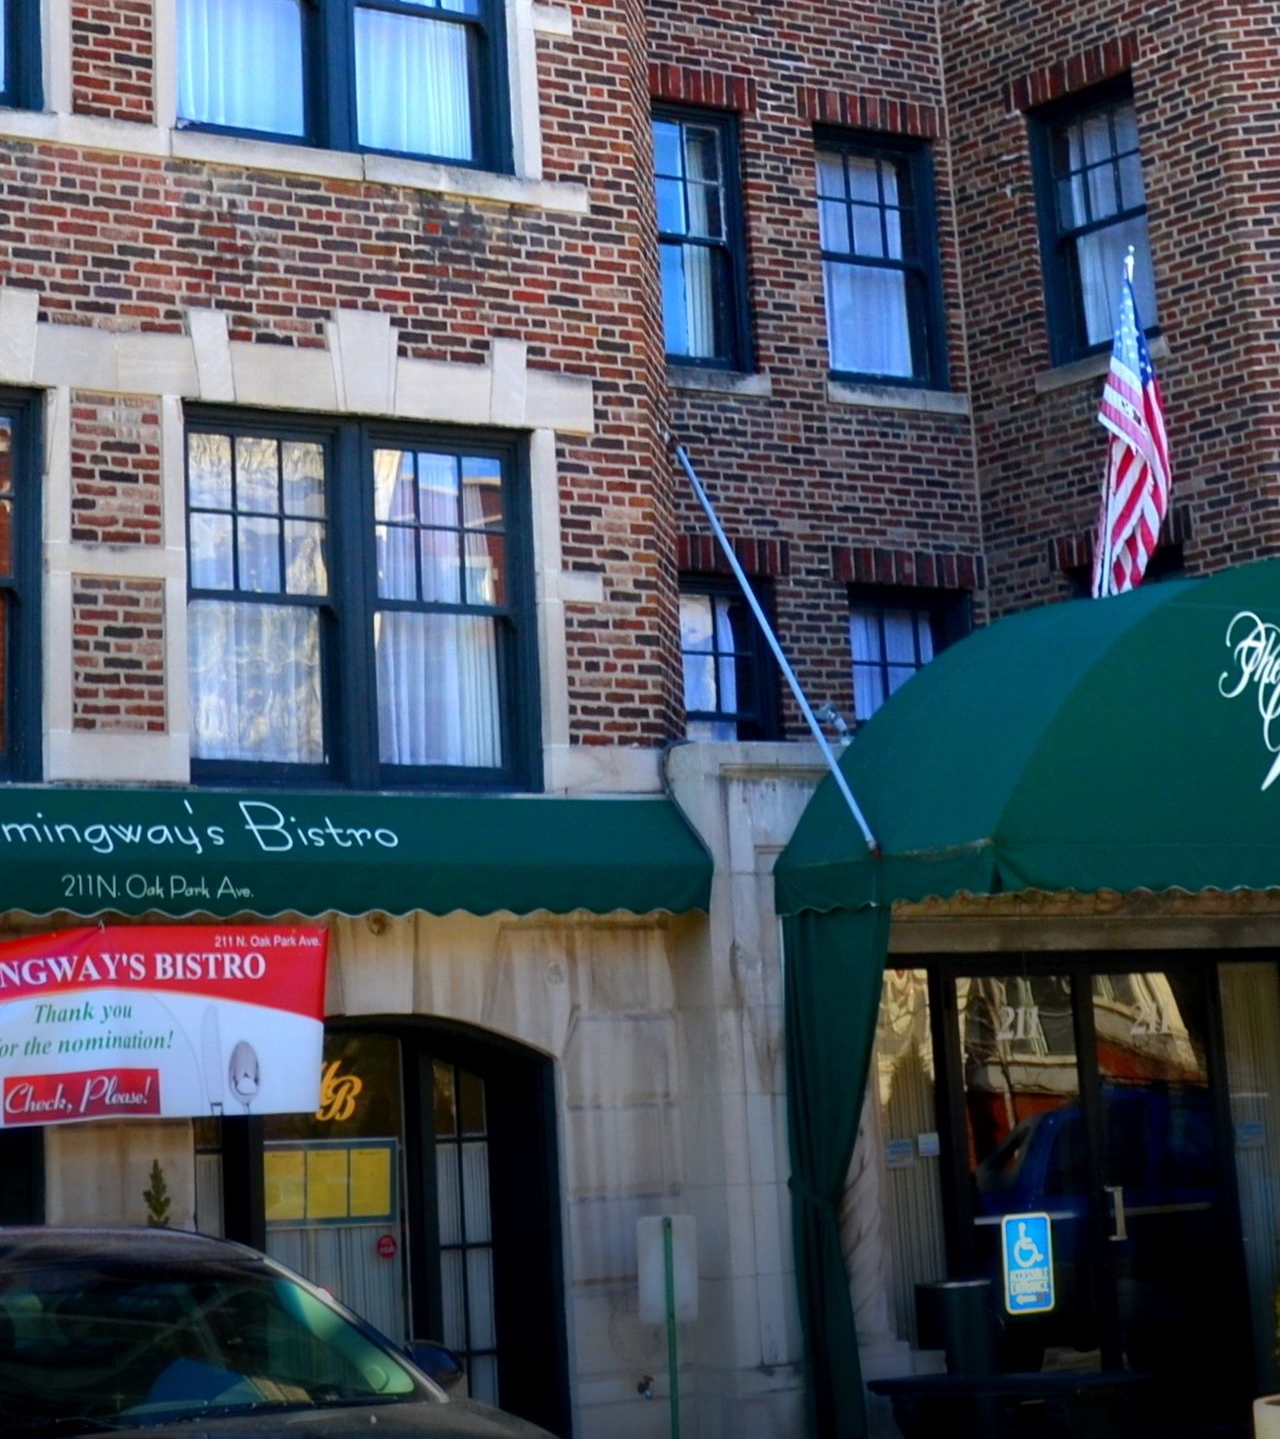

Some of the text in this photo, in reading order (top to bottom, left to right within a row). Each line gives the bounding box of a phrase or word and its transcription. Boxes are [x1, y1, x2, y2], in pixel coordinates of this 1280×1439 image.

[238, 800, 399, 852] Bistro
[125, 874, 165, 899] Oak
[170, 875, 210, 898] Park
[216, 875, 254, 899] Ave.
[214, 935, 233, 948] 211
[250, 935, 271, 947] Oak
[273, 934, 297, 947] Park
[298, 934, 322, 947] Ave.
[154, 952, 266, 980] BISTRO
[35, 1002, 132, 1025] Thank you
[23, 1036, 52, 1057] the
[57, 1030, 175, 1054] nomination!
[5, 1075, 152, 1114] Check, Please!
